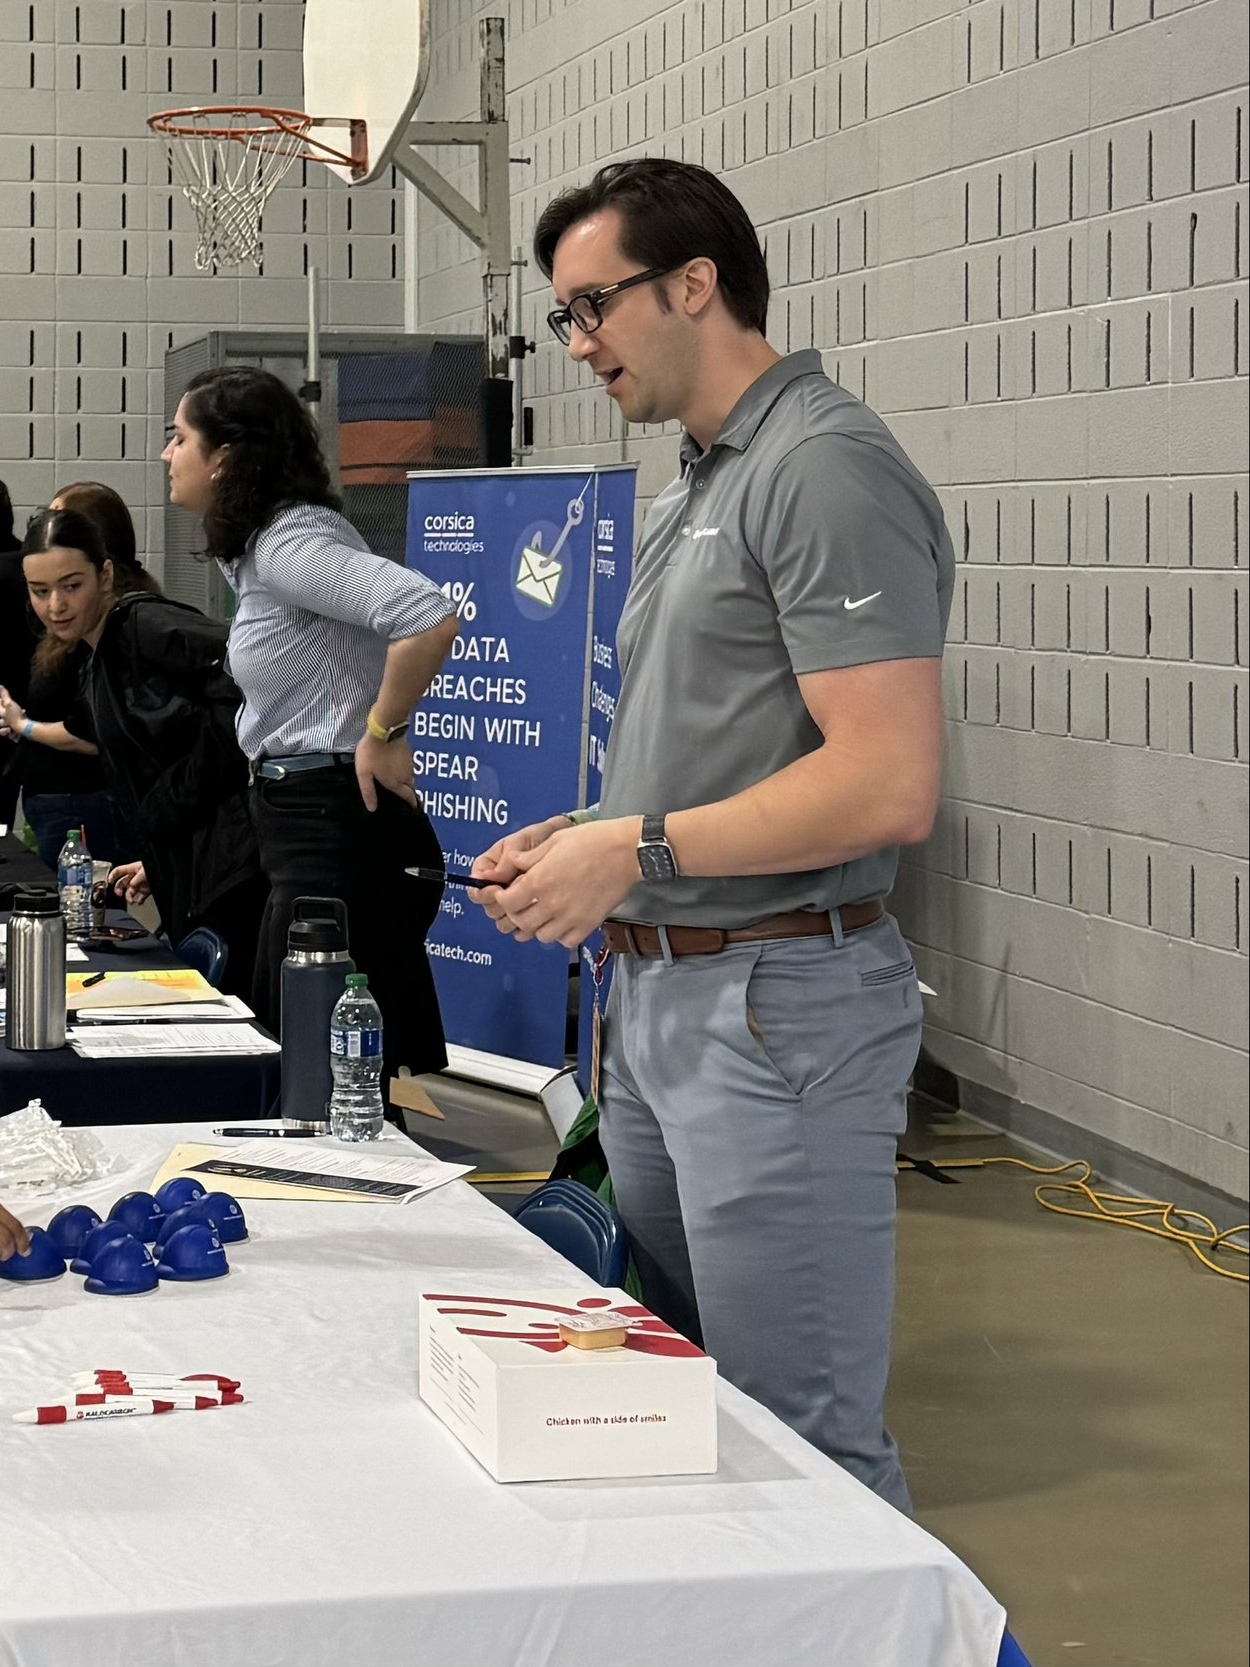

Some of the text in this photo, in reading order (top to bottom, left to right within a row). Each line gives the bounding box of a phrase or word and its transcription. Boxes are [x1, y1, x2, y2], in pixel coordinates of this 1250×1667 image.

[424, 511, 475, 530] corsica
[423, 540, 485, 555] technologies
[451, 635, 510, 663] DATA
[422, 674, 527, 705] REACHES
[414, 711, 541, 747] BEGIN WITH
[412, 750, 479, 782] SPEAR
[546, 1416, 581, 1426] Chicken
[583, 1416, 602, 1425] with
[629, 1414, 639, 1423] of
